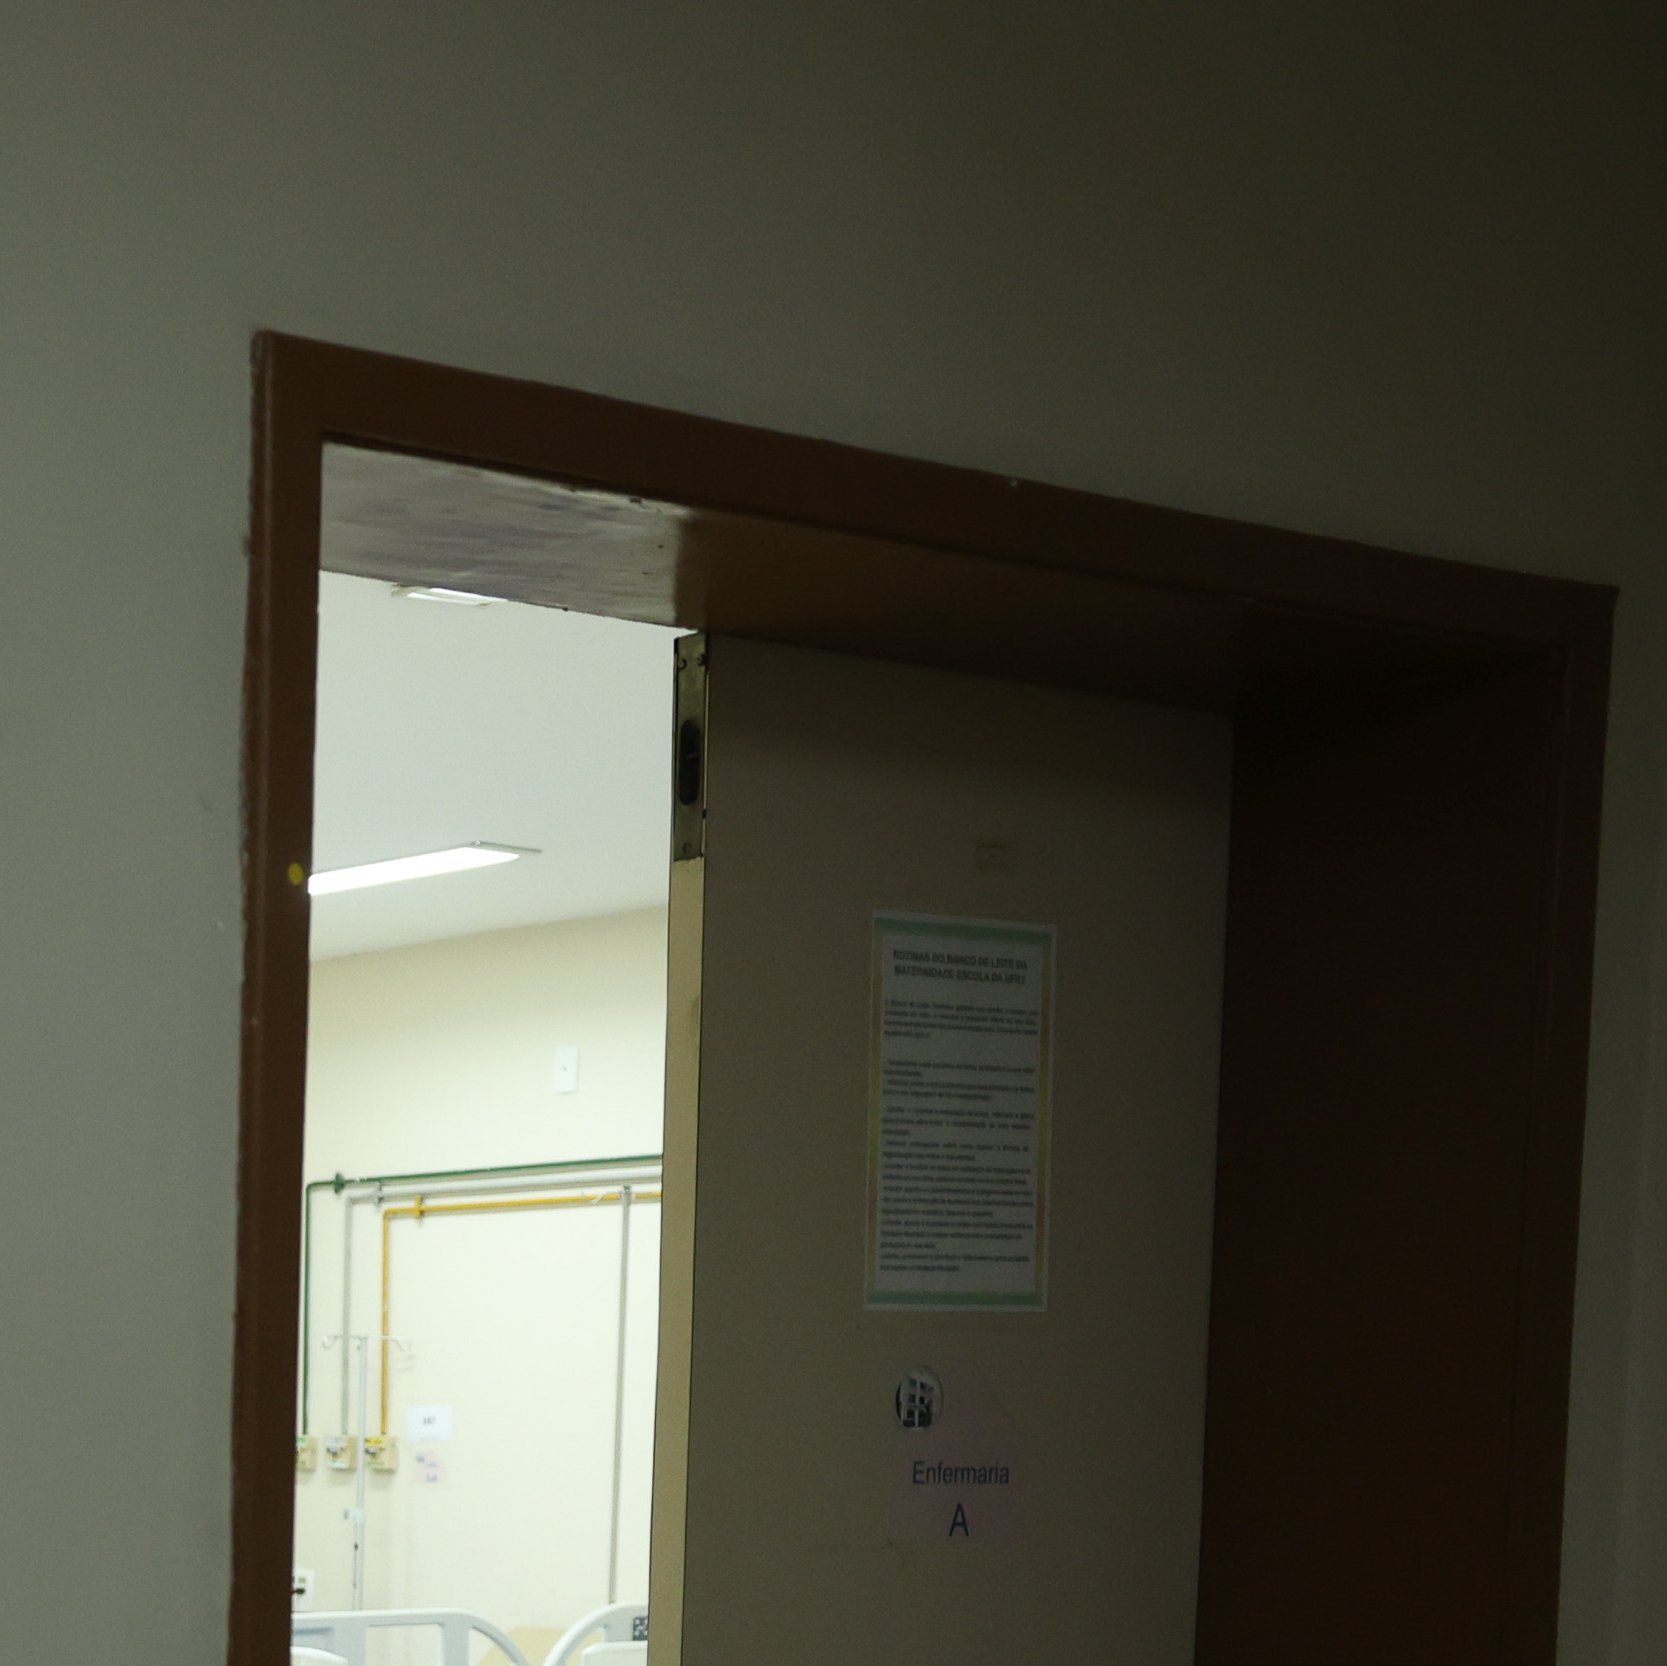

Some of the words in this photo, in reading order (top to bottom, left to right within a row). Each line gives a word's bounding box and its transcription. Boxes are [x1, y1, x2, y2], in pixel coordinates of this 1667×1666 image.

[893, 949, 930, 962] ROTINAS
[932, 953, 945, 963] DO
[947, 954, 976, 966] BANCO
[978, 956, 989, 967] DE
[991, 957, 1014, 969] LEITE
[1016, 960, 1028, 970] DA
[894, 965, 954, 979] MATERNIDADE
[956, 969, 990, 982] ESCOLA
[991, 972, 1003, 982] DA
[1005, 973, 1025, 984] UFRJ
[912, 1461, 1009, 1485] Enfermaria
[948, 1501, 970, 1538] A
